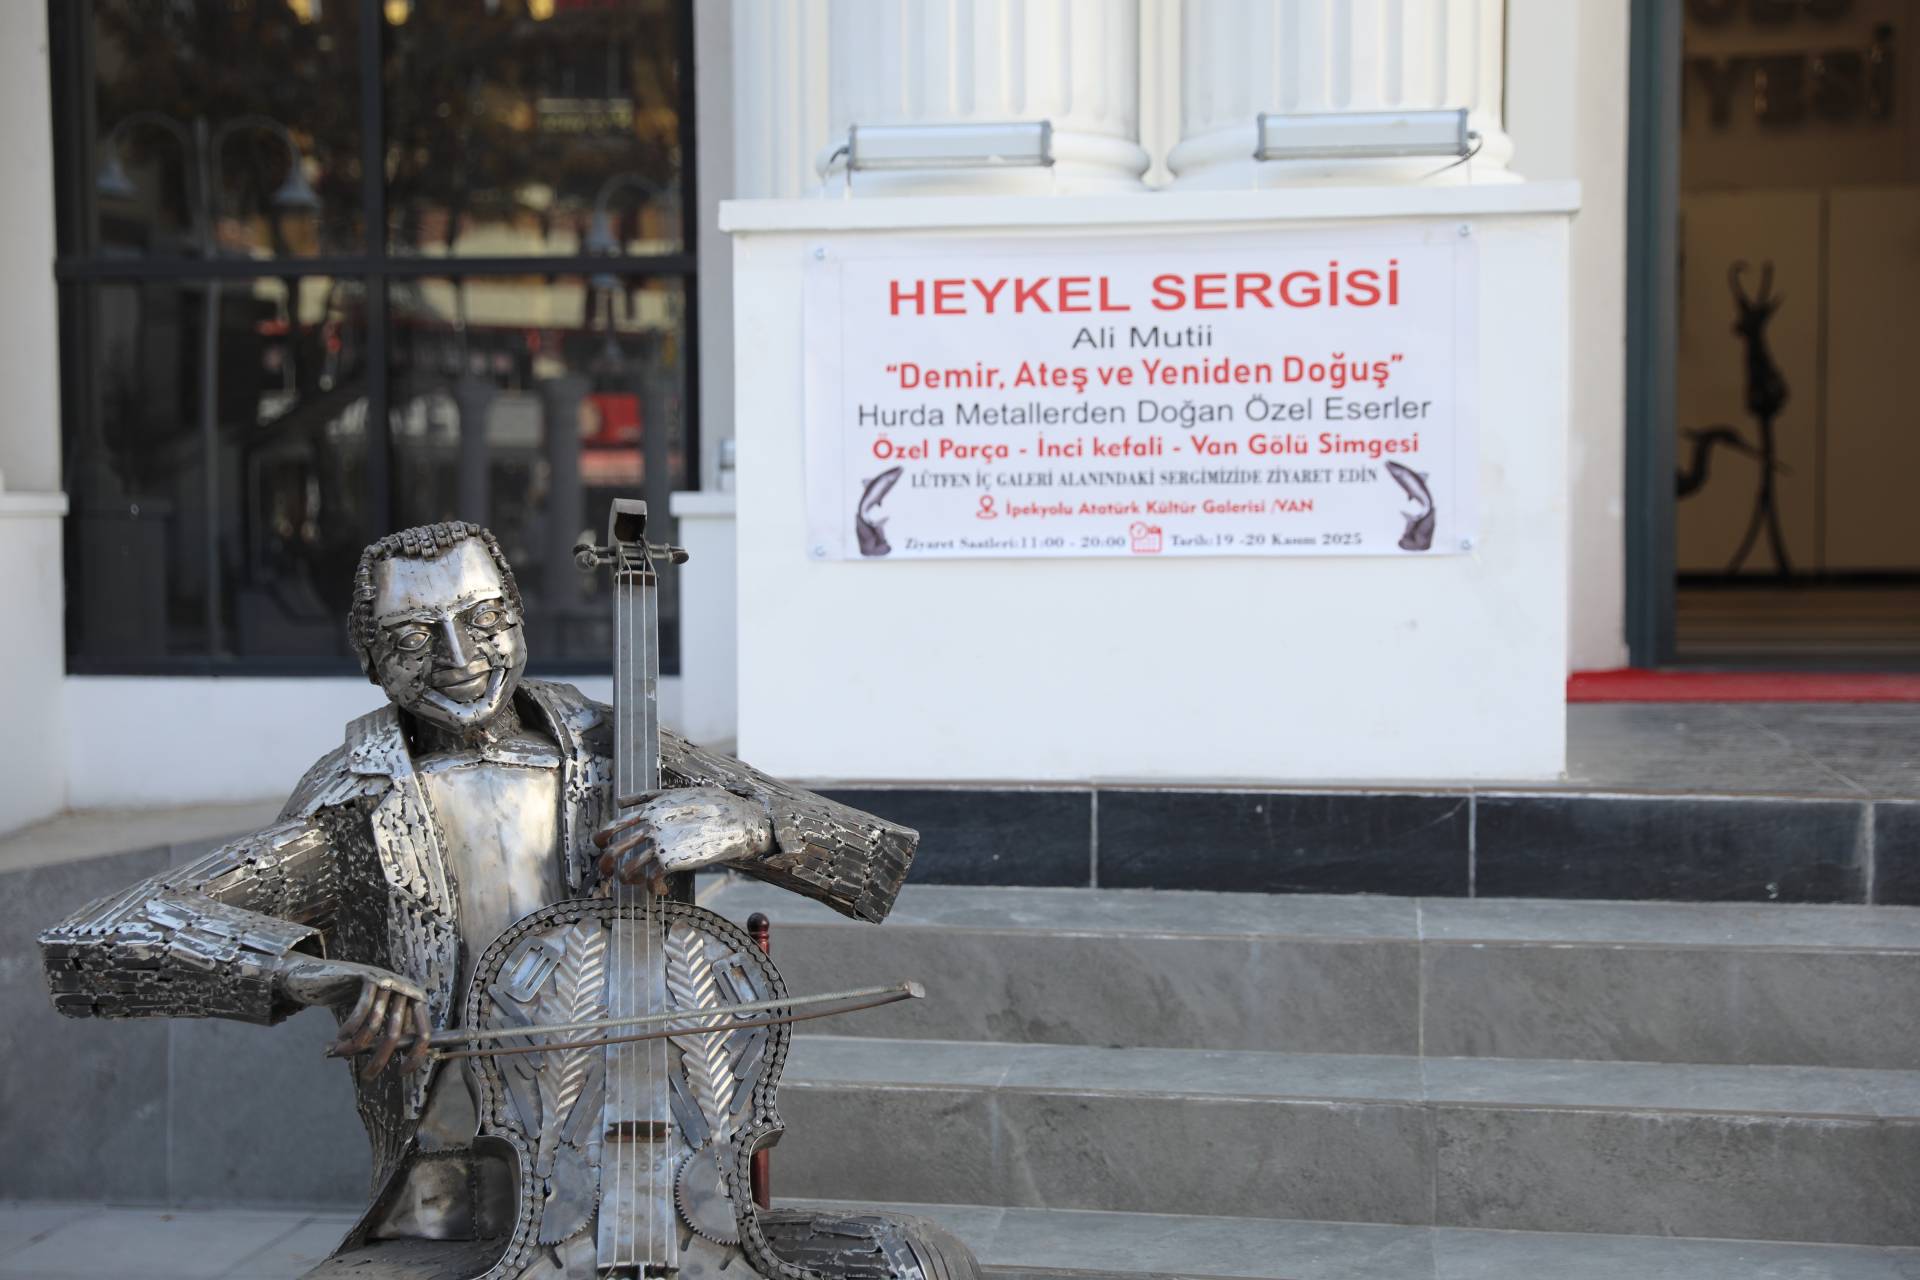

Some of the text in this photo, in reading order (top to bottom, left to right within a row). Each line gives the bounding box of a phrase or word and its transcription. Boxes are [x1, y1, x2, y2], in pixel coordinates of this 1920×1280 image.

[890, 259, 1399, 316] HEYKEL SERGİSİ
[1072, 325, 1213, 350] Ali Mutii
[1014, 361, 1089, 393] Ateş
[1098, 367, 1133, 386] ve
[1142, 358, 1272, 385] Yeniden
[858, 394, 1431, 428] Hurda Metallerden Doğan Özel Eserler
[873, 433, 928, 460] Özel
[940, 438, 1009, 464] Parça
[1038, 431, 1083, 458] İnci
[1093, 436, 1163, 458] kefali
[1191, 435, 1238, 456] Van
[1249, 433, 1308, 455] Gölü
[1319, 433, 1419, 459] Simgesi
[911, 470, 970, 488] LÜTFEN
[976, 469, 993, 491] İÇ
[996, 470, 1053, 487] GALERİ
[1060, 467, 1155, 487] ALANINDAKİ
[1267, 466, 1332, 485] ZİYARET
[1339, 466, 1378, 483] EDİN
[1079, 501, 1140, 516] Atatürk
[1147, 500, 1197, 514] Kültür
[1203, 500, 1266, 514] Galerisi
[1322, 532, 1363, 545] 2025
